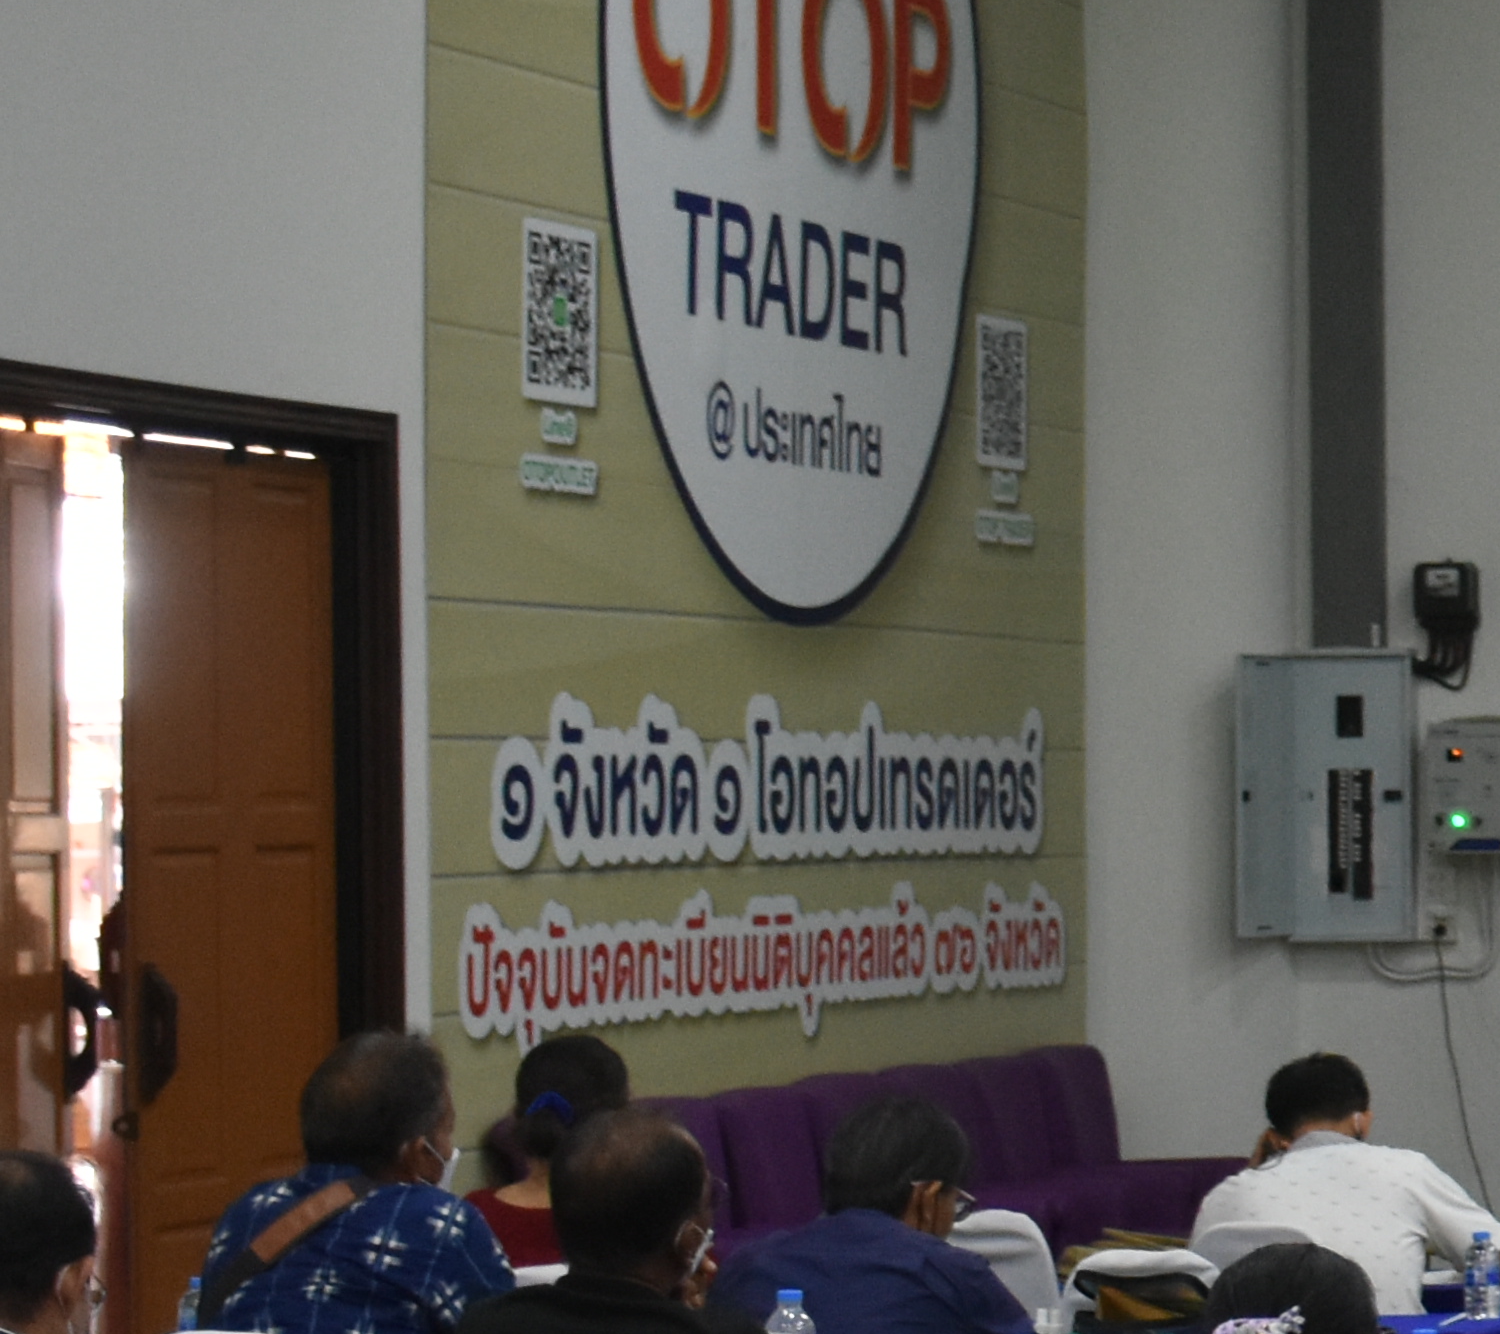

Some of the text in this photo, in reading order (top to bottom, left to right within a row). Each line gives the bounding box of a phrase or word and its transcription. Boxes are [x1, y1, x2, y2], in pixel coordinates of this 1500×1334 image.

[673, 188, 909, 358] TRADER
[706, 379, 883, 478] @ ประเทศไทย
[502, 719, 1039, 841] ๑ จังหวัด ๑ โอทอปเทรดเดอร์
[986, 898, 1061, 973] จังหวัด
